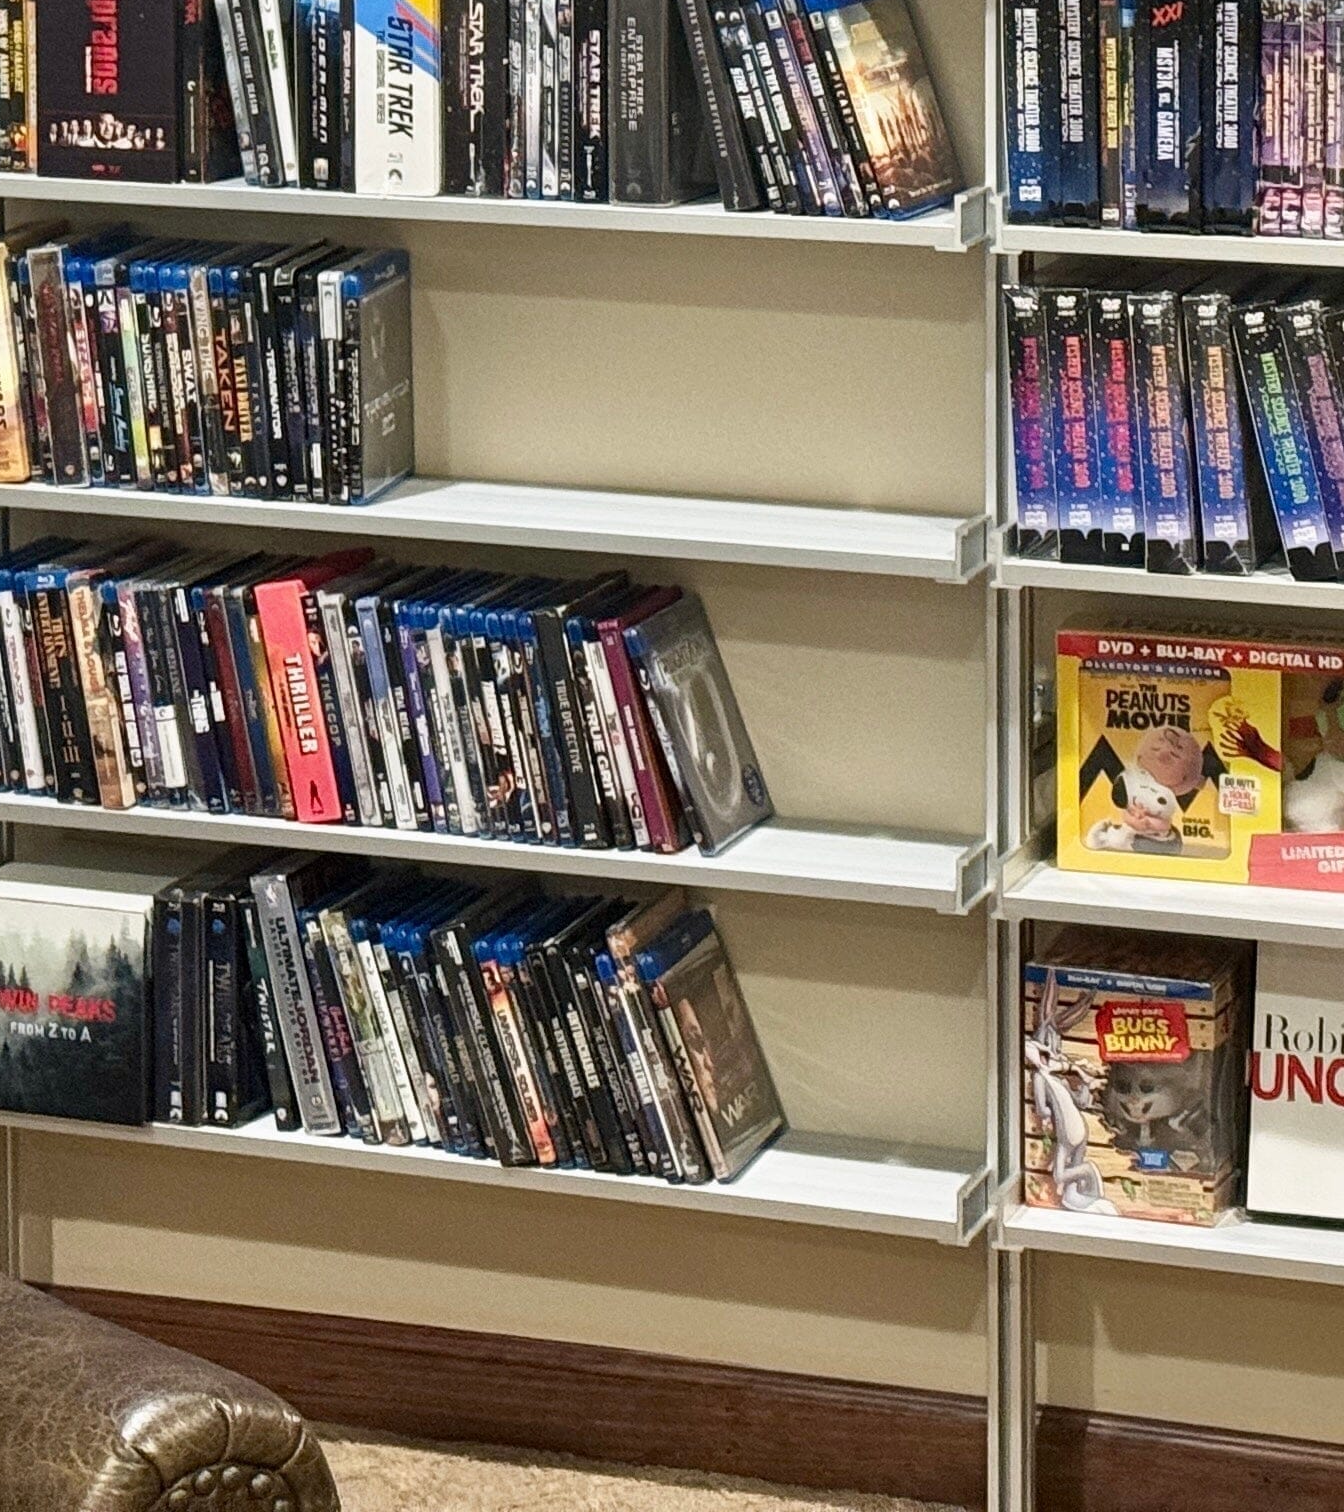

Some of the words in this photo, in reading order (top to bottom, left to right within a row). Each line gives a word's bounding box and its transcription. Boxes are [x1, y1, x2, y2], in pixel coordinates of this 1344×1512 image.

[387, 17, 413, 75] STAR
[1023, 8, 1037, 48] MYSTERY
[589, 29, 600, 85] STAR
[627, 17, 638, 132] ENTERPRISE
[636, 34, 644, 73] STAR
[1024, 50, 1038, 87] SCIENCE
[1156, 47, 1174, 89] MST3K
[388, 83, 414, 139] TREK
[589, 87, 600, 138] TREK
[636, 76, 644, 115] TREK
[1024, 89, 1039, 125] THEATER
[1025, 127, 1040, 152] 3000
[1156, 111, 1174, 160] GAMERA
[193, 290, 211, 341] SWING
[140, 334, 157, 411] SUNSHINE
[200, 342, 214, 380] TIME
[215, 329, 235, 432] TAKEN
[234, 356, 249, 389] TAXI
[1260, 352, 1280, 394] MYSTERY
[265, 350, 282, 439] TERMINATOR
[237, 391, 252, 442] DRIVER
[1269, 397, 1289, 436] SCIENCE
[1279, 437, 1299, 476] THEATER
[1288, 477, 1308, 504] 3000
[1097, 640, 1133, 656] DVD
[1249, 649, 1313, 670] DIGITAL
[1319, 655, 1342, 671] HD
[283, 653, 317, 754] THRILLER
[556, 679, 570, 709] TRUE
[1105, 689, 1190, 713] PEANUTS
[1138, 682, 1158, 693] THE
[320, 673, 341, 746] TIMECOP
[1105, 713, 1191, 730] MOVIE
[561, 711, 583, 773] DETECTIVE
[585, 702, 606, 753] TRUE
[596, 757, 616, 801] GRIT
[256, 978, 277, 1054] TWISTER
[276, 917, 302, 1001] ULTIMATE
[293, 1001, 320, 1084] JORDAN
[1104, 1032, 1179, 1054] BUNNY
[1111, 1014, 1170, 1038] BUGS
[671, 1046, 705, 1113] WAR
